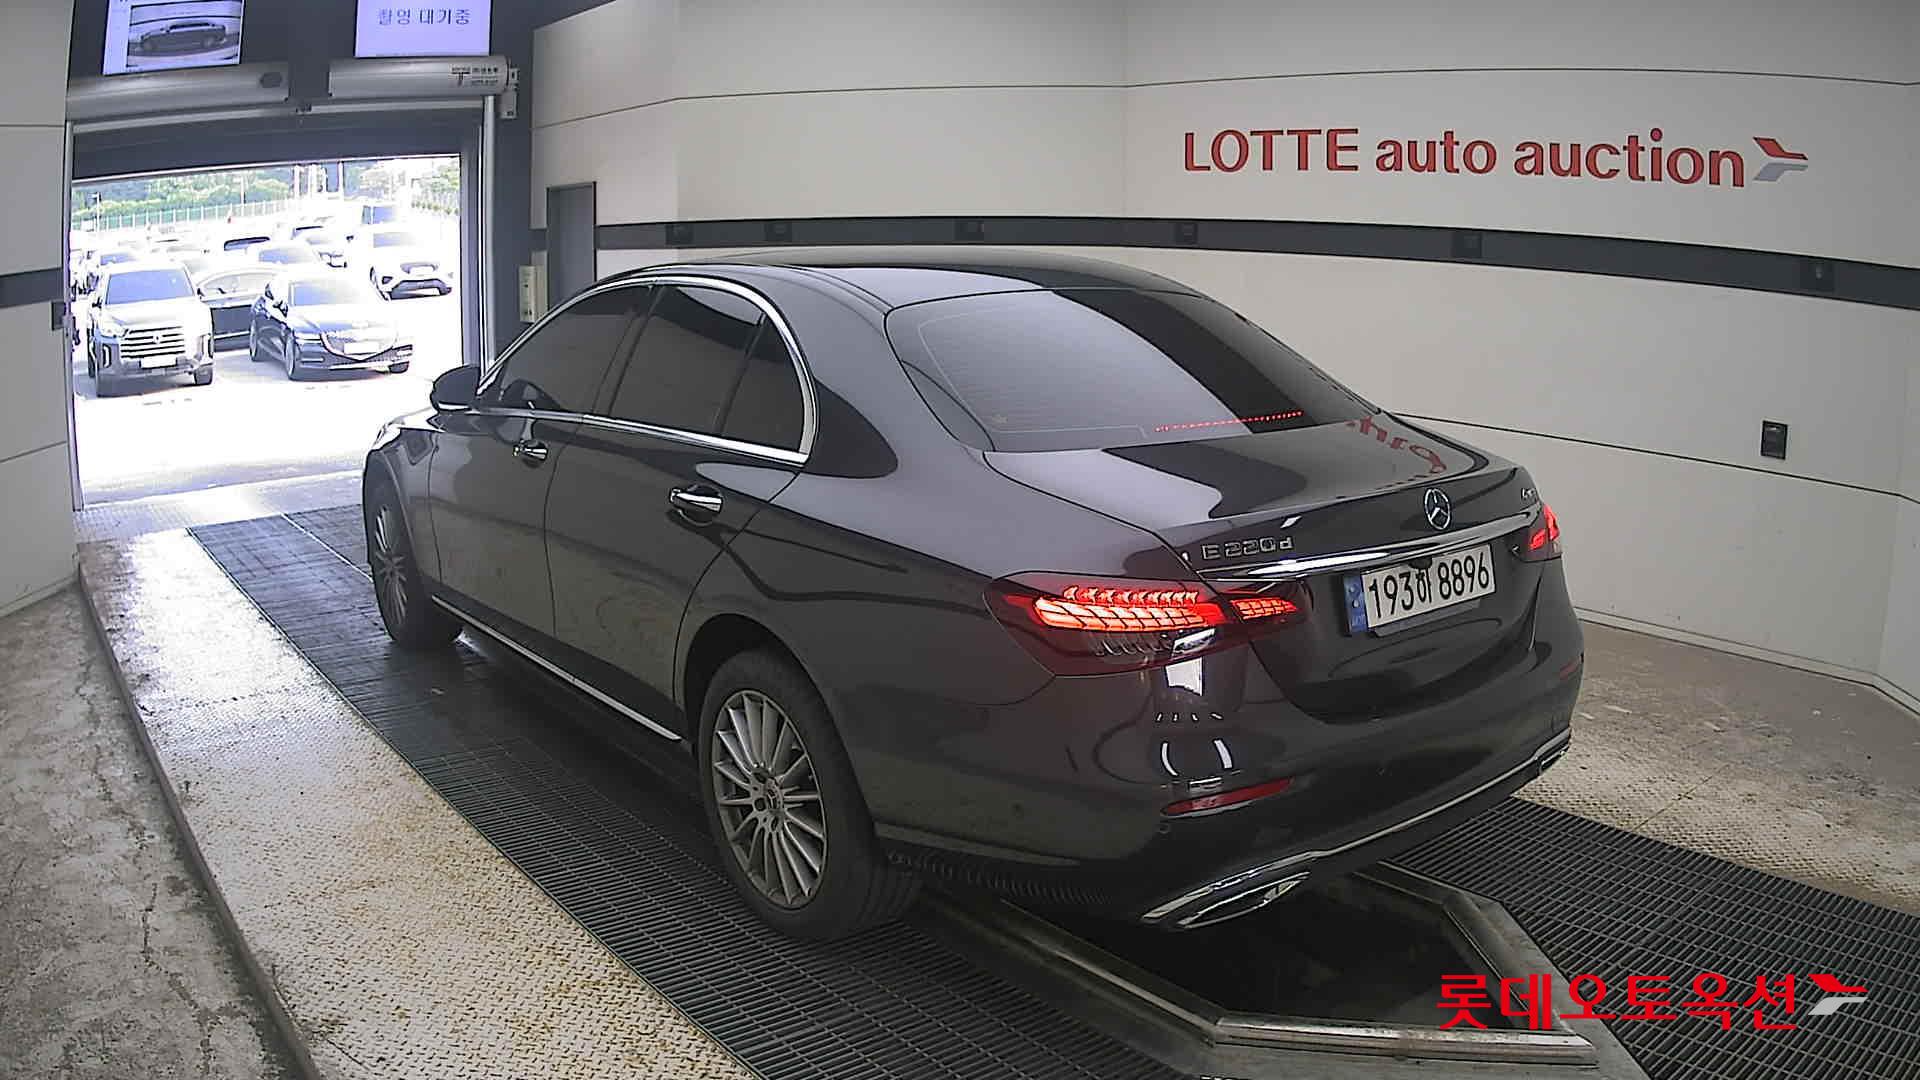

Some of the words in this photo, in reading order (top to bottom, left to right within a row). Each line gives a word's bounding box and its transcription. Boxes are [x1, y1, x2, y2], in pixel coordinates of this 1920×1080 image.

[419, 8, 470, 25] 대기중
[1183, 128, 1360, 173] LOTTE
[1375, 130, 1498, 175] auto
[1513, 128, 1746, 188] auction
[1437, 551, 1490, 600] 8896
